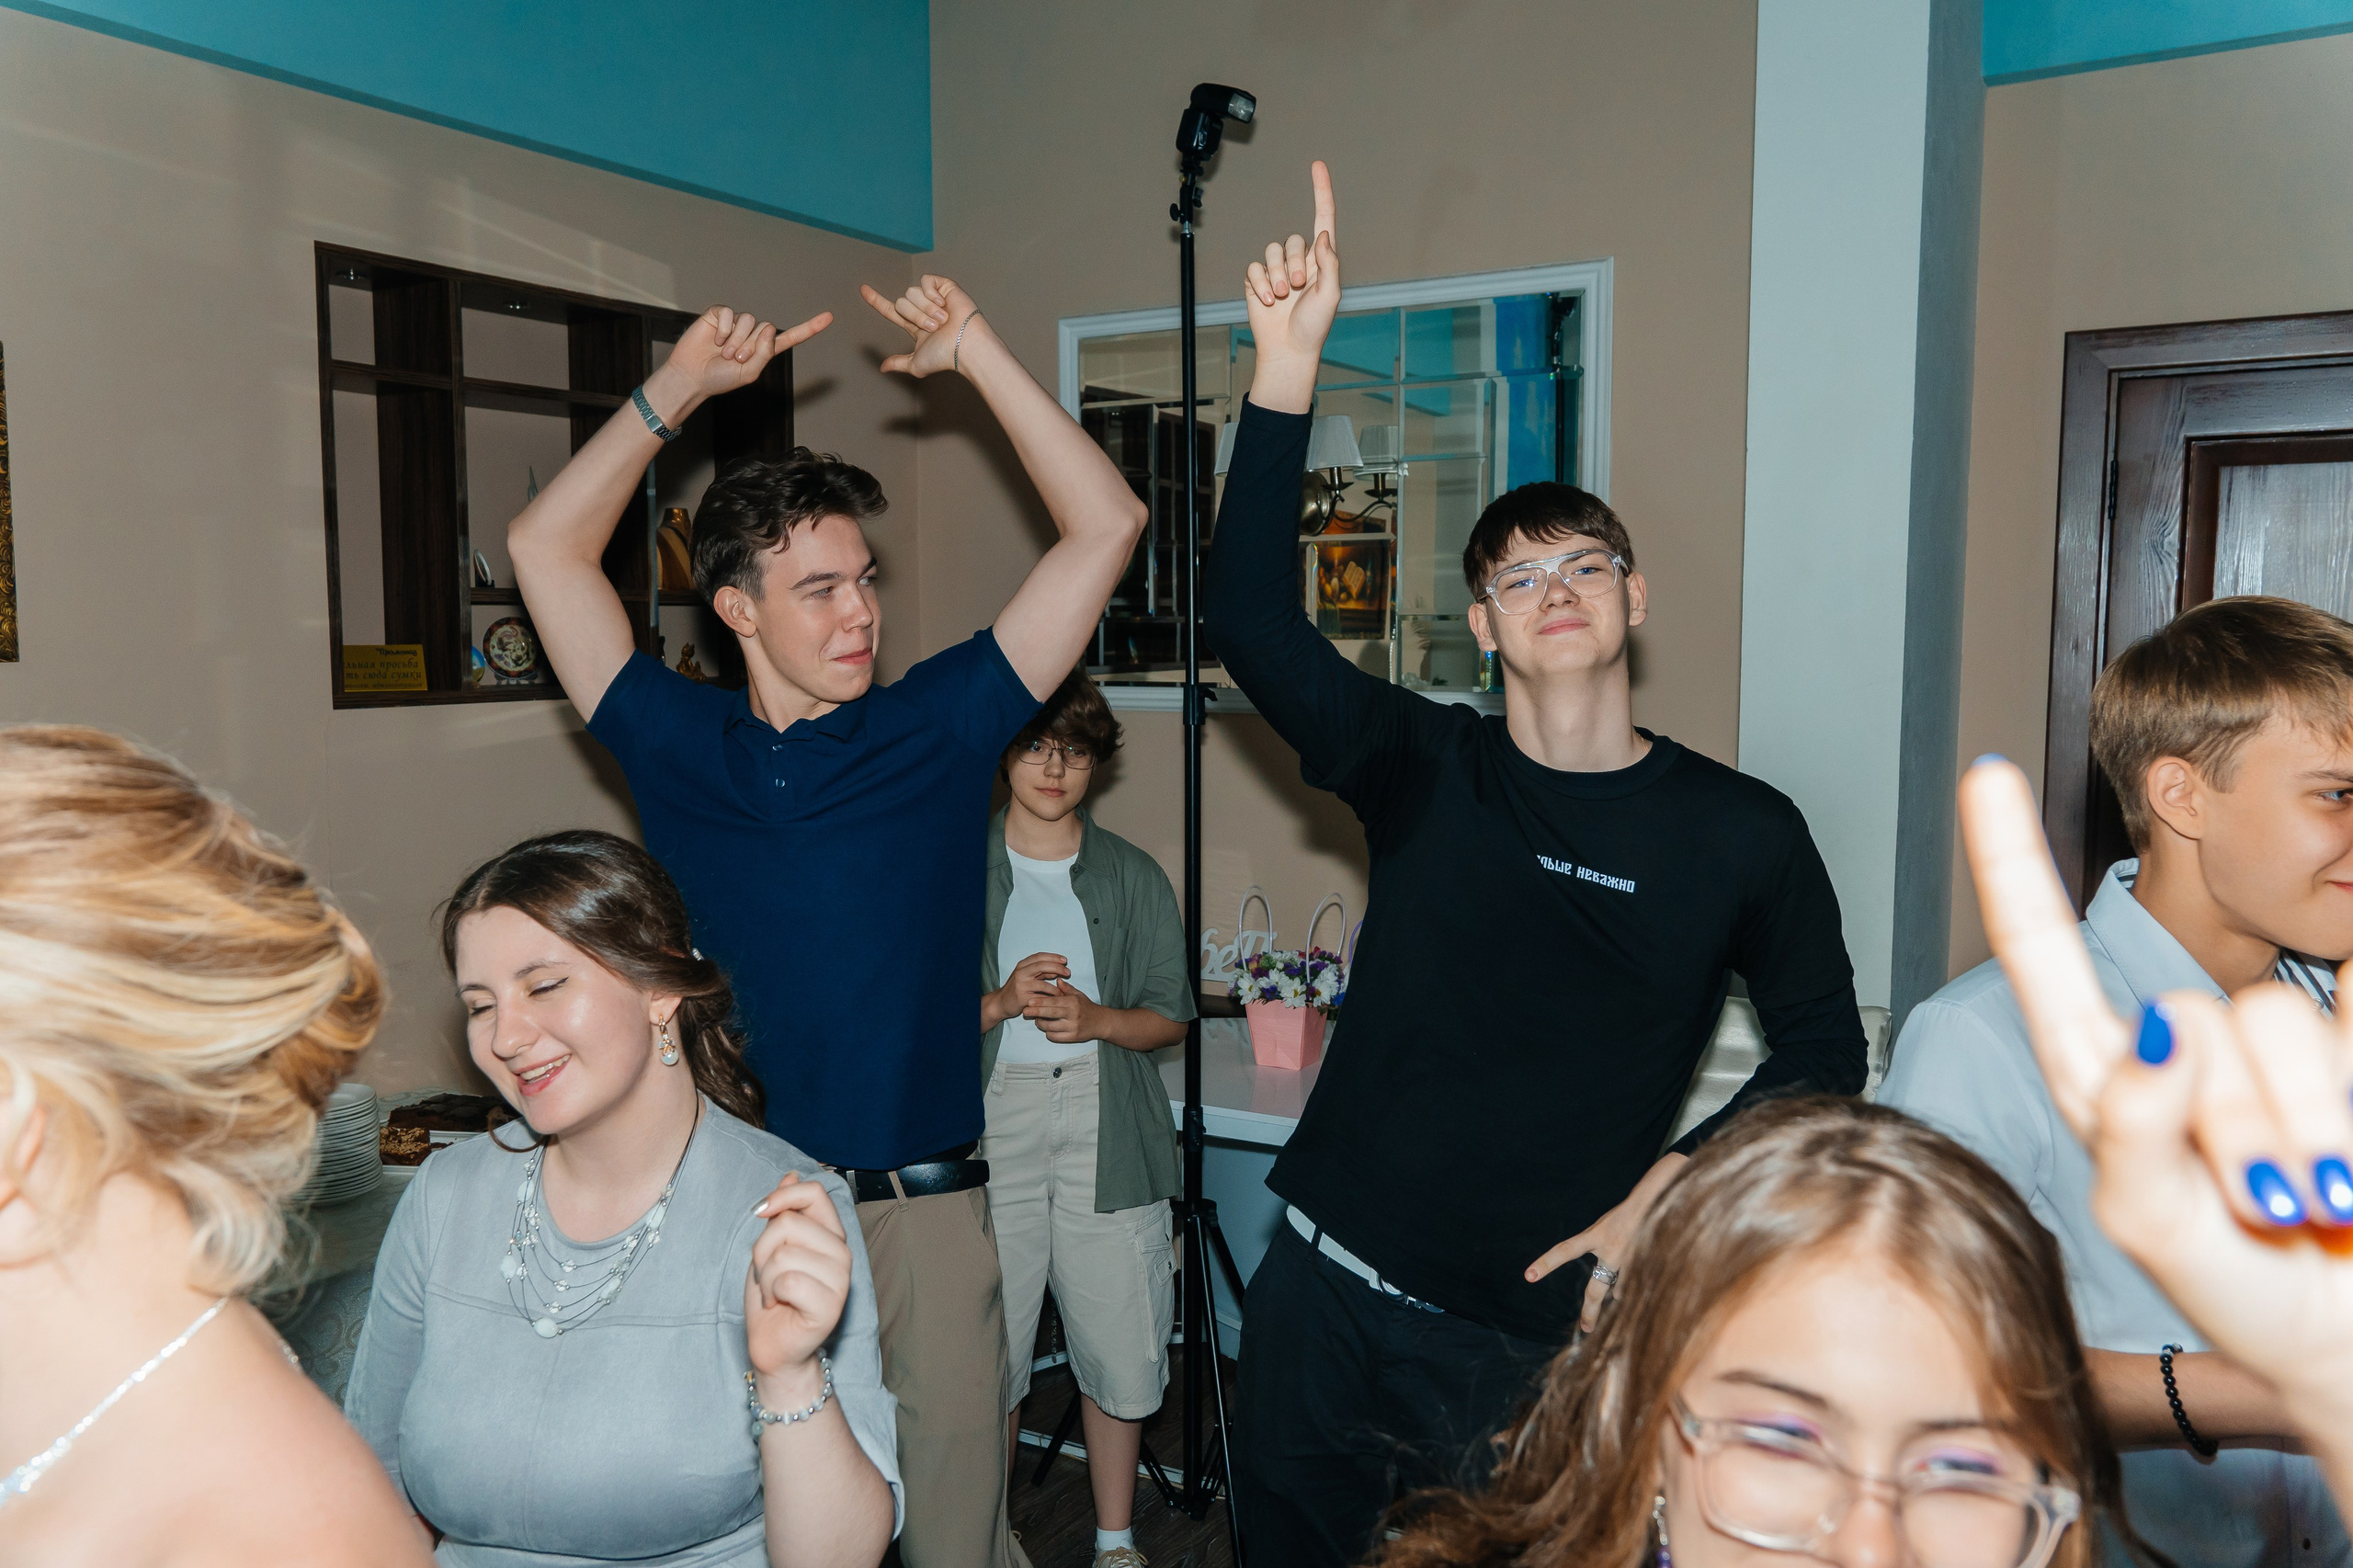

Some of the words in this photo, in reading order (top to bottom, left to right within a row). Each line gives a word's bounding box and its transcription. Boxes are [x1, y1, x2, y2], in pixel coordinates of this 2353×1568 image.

[380, 657, 419, 672] просьба
[363, 669, 387, 680] сюда
[391, 671, 422, 683] сумки
[1536, 854, 1573, 876] льше
[1576, 866, 1636, 893] неважно
